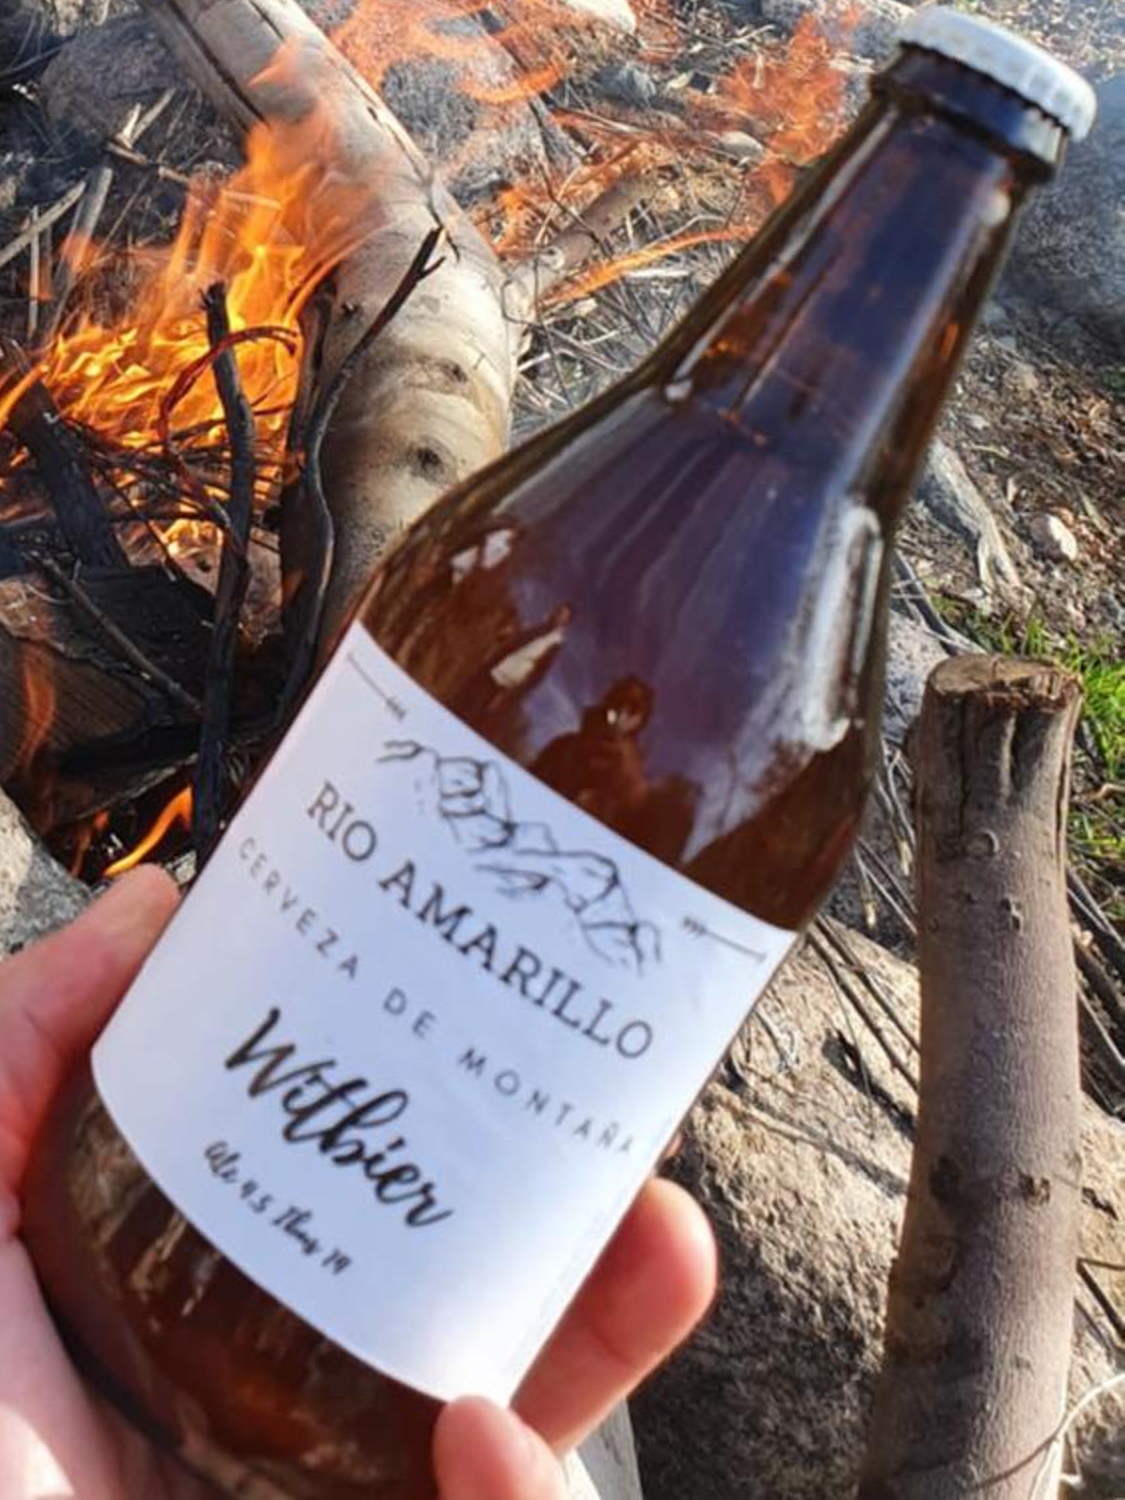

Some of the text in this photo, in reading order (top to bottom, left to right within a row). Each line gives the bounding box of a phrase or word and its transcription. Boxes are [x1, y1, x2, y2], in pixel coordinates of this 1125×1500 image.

[238, 836, 634, 1153] CERVEZA DE MONTAÑA
[306, 781, 654, 1060] RIO AMARILLO
[225, 1006, 455, 1228] Witbier
